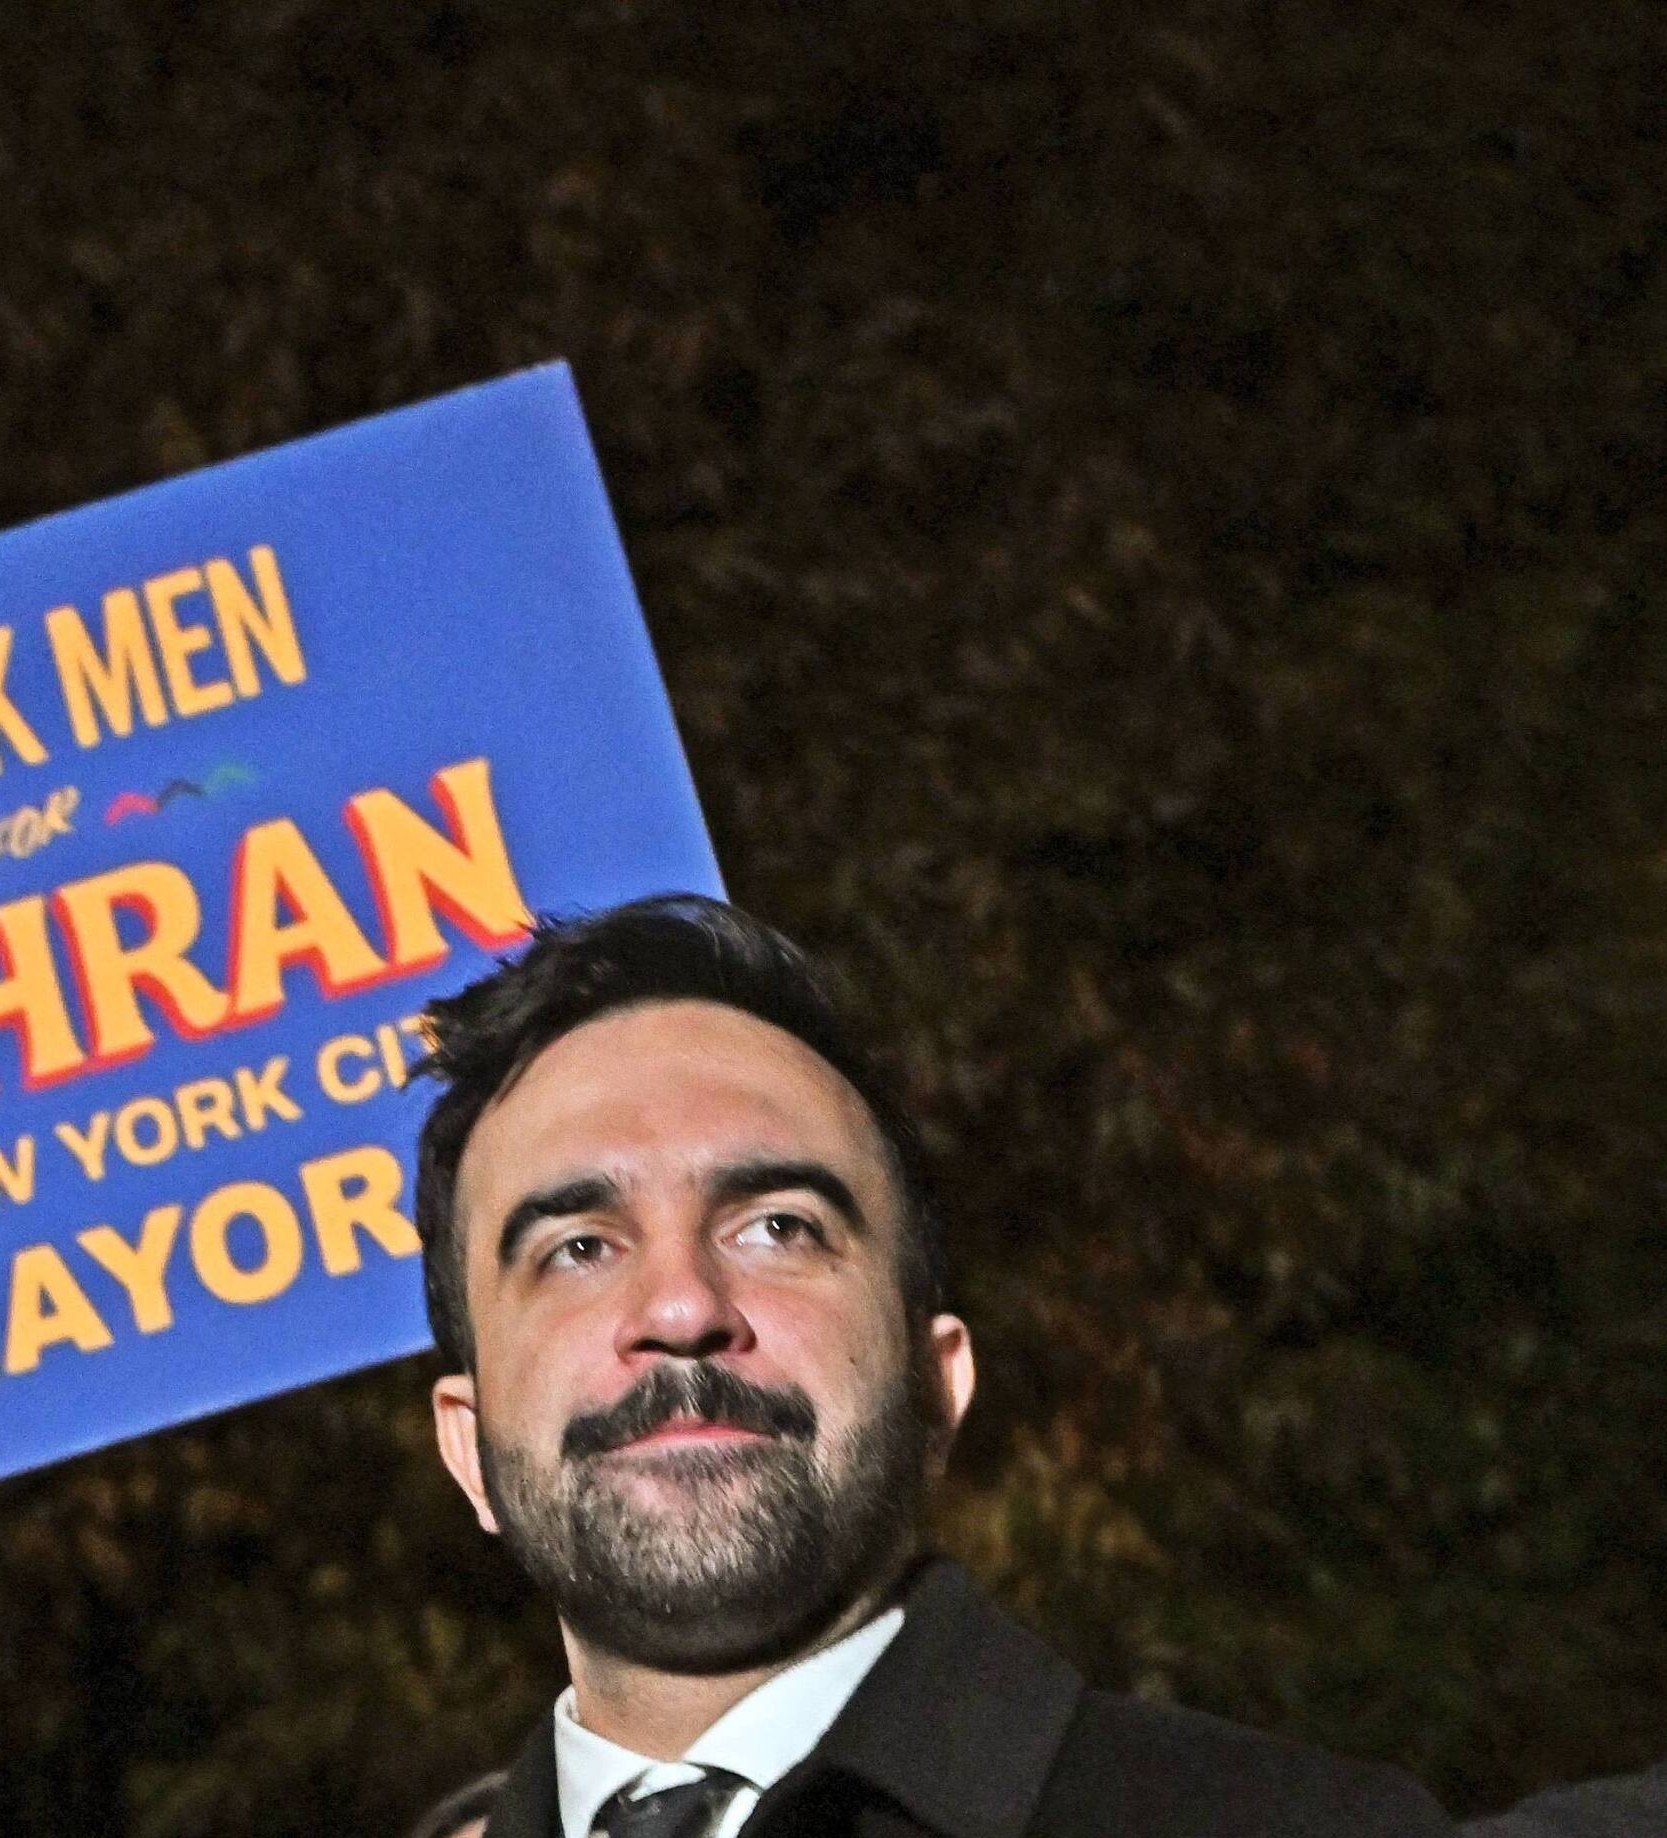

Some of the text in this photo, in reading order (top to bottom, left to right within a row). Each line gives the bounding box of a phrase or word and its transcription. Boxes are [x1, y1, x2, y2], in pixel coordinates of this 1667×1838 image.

[45, 545, 307, 748] MEN
[55, 1057, 302, 1181] YORK
[317, 1011, 442, 1104] CIT
